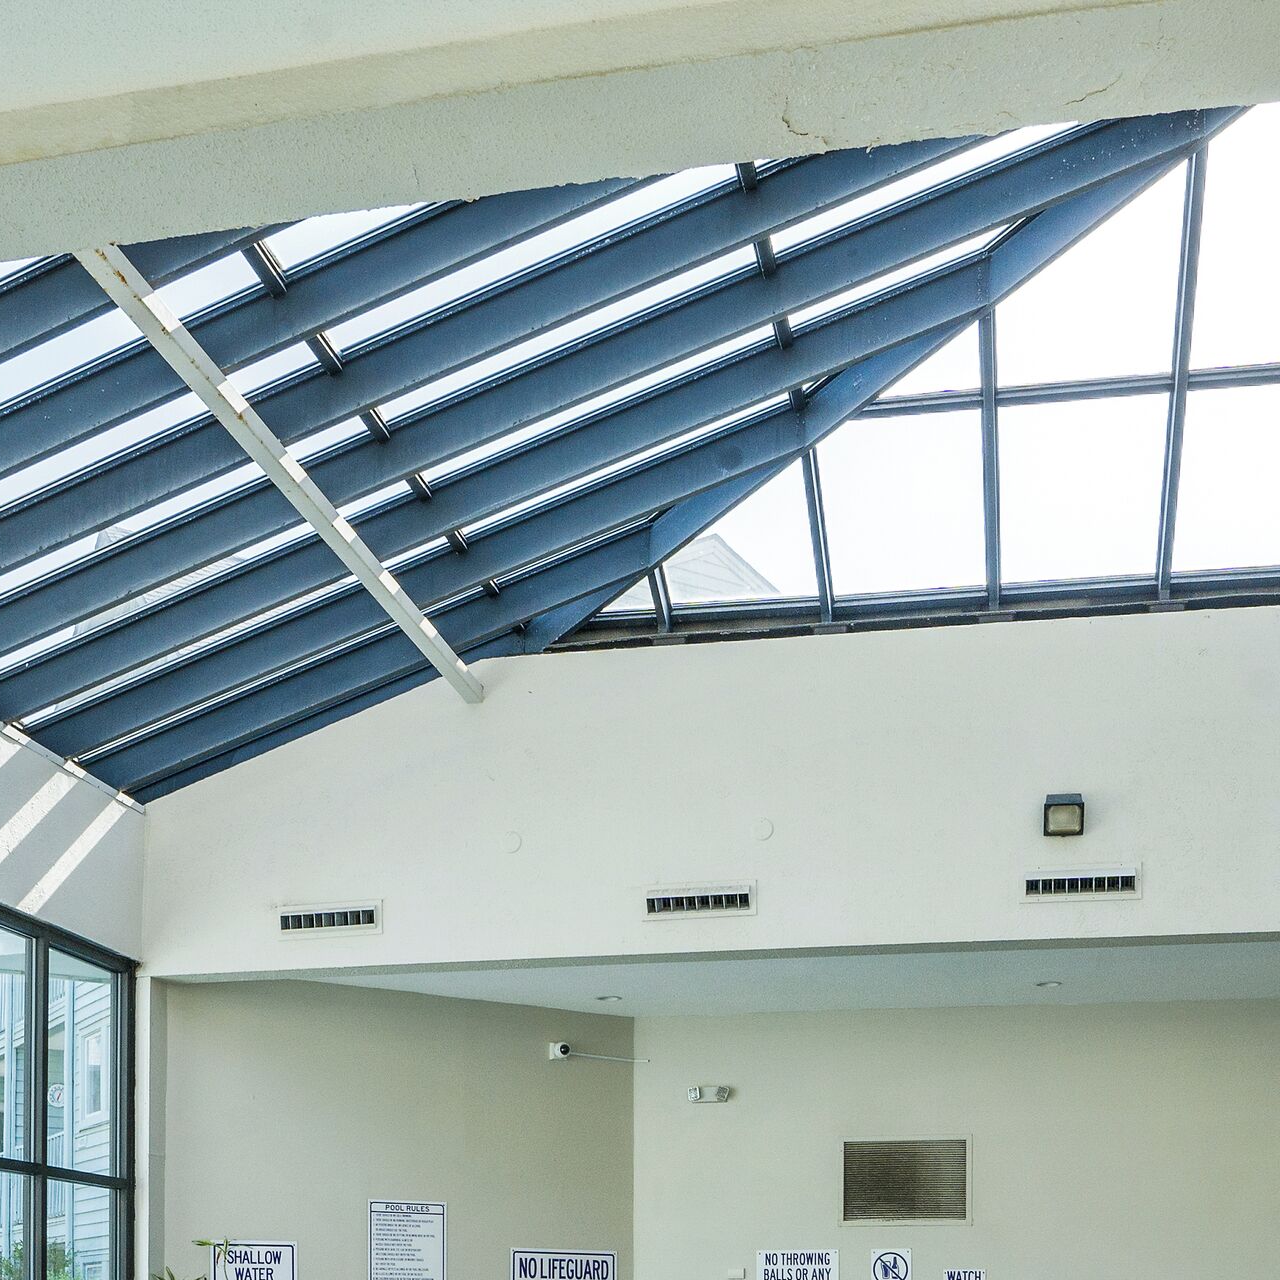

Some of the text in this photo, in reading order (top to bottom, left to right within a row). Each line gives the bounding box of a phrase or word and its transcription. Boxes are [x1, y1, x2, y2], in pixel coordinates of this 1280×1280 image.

[385, 1204, 430, 1213] POOL RULES
[227, 1250, 282, 1265] SHALLOW
[765, 1252, 831, 1266] NO THROWING
[519, 1257, 609, 1280] NO LIFEGUARD
[763, 1267, 832, 1280] BALLS OR ANY
